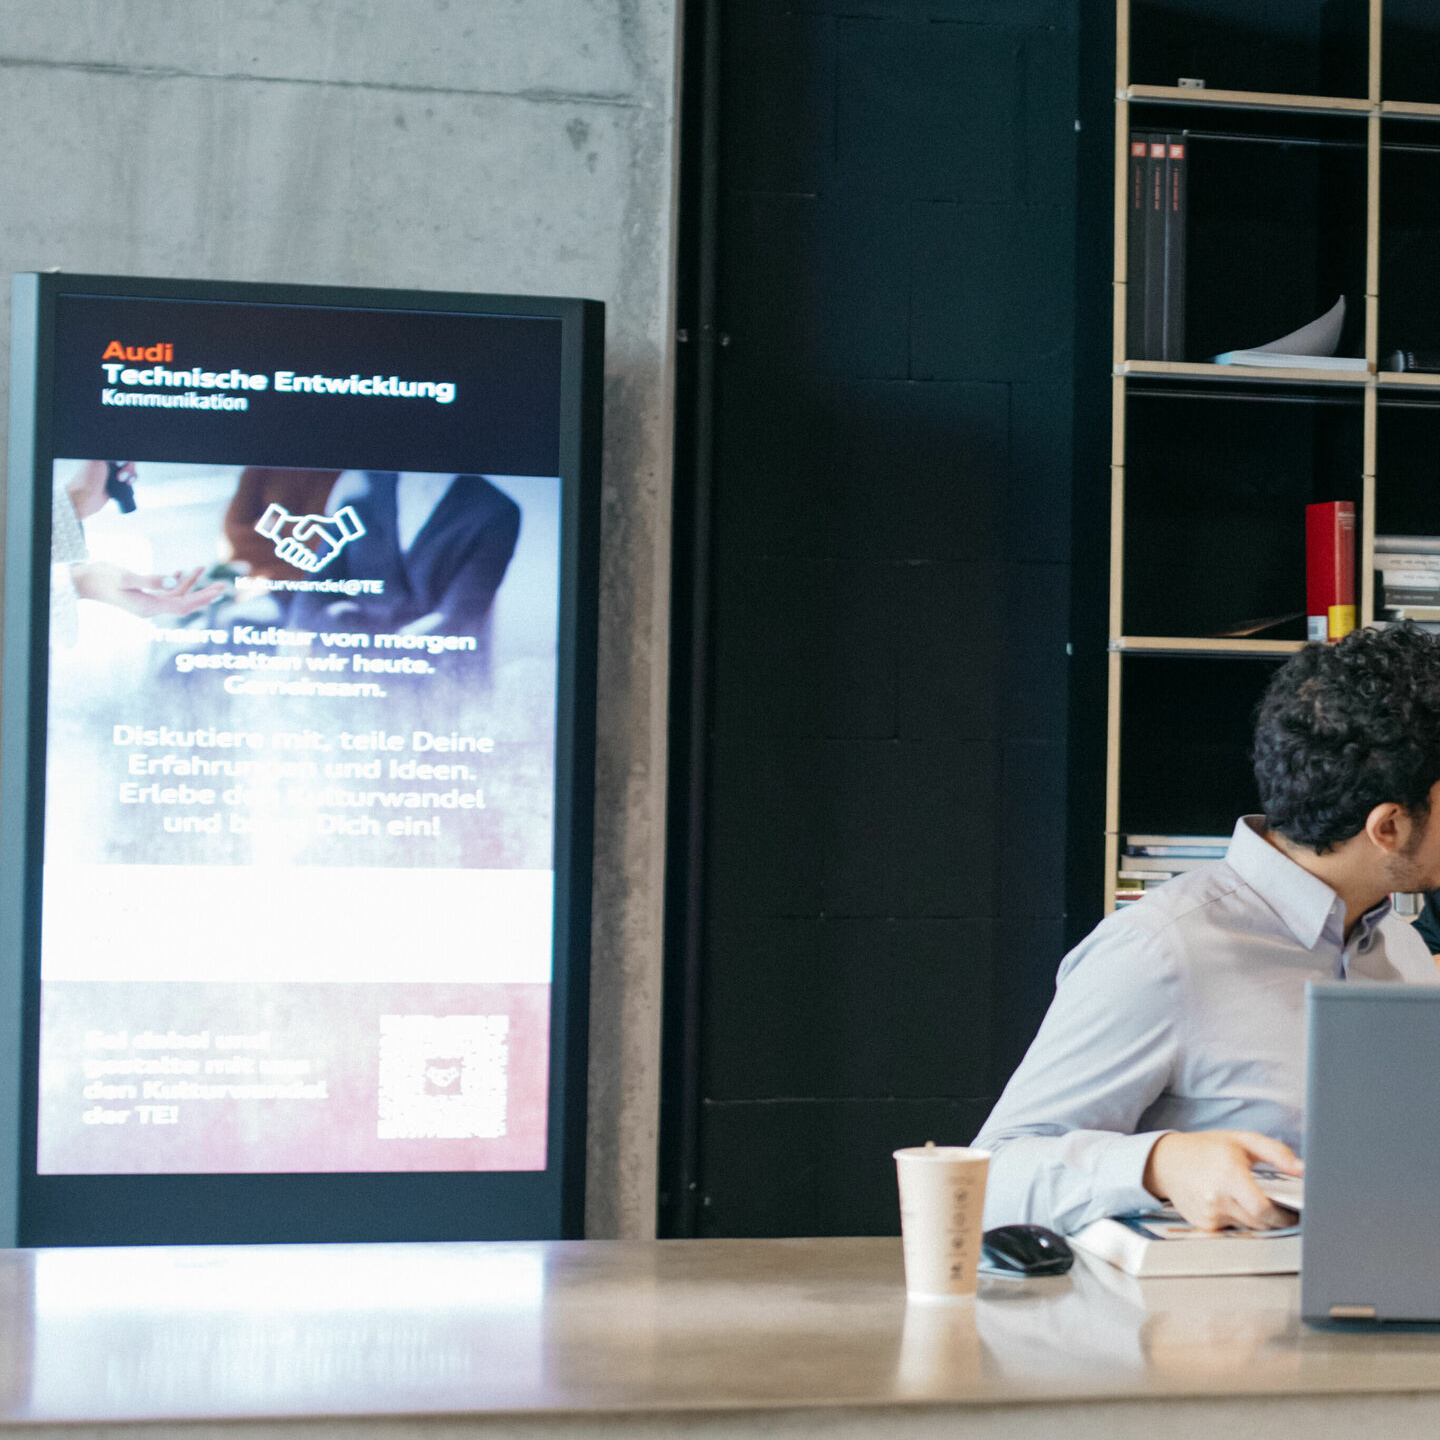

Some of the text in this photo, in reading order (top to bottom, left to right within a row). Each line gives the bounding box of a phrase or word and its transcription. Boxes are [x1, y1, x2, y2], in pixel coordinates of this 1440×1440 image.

[102, 340, 174, 362] Audi
[101, 363, 456, 403] Technische Entwicklung
[101, 388, 249, 411] Kommunikation
[233, 626, 315, 646] Kultur
[321, 632, 368, 648] von
[374, 631, 476, 653] morgen
[175, 651, 435, 674] gestalten wir heute.
[223, 675, 387, 697] Gemeinsam.
[112, 724, 265, 750] Diskutiere
[340, 729, 405, 751] teile
[412, 731, 495, 753] Deine
[324, 759, 381, 780] und
[389, 760, 478, 781] Ideen.
[118, 782, 216, 806] Erlebe
[163, 812, 222, 835] und
[315, 815, 381, 836] Dich
[386, 816, 441, 837] ein!
